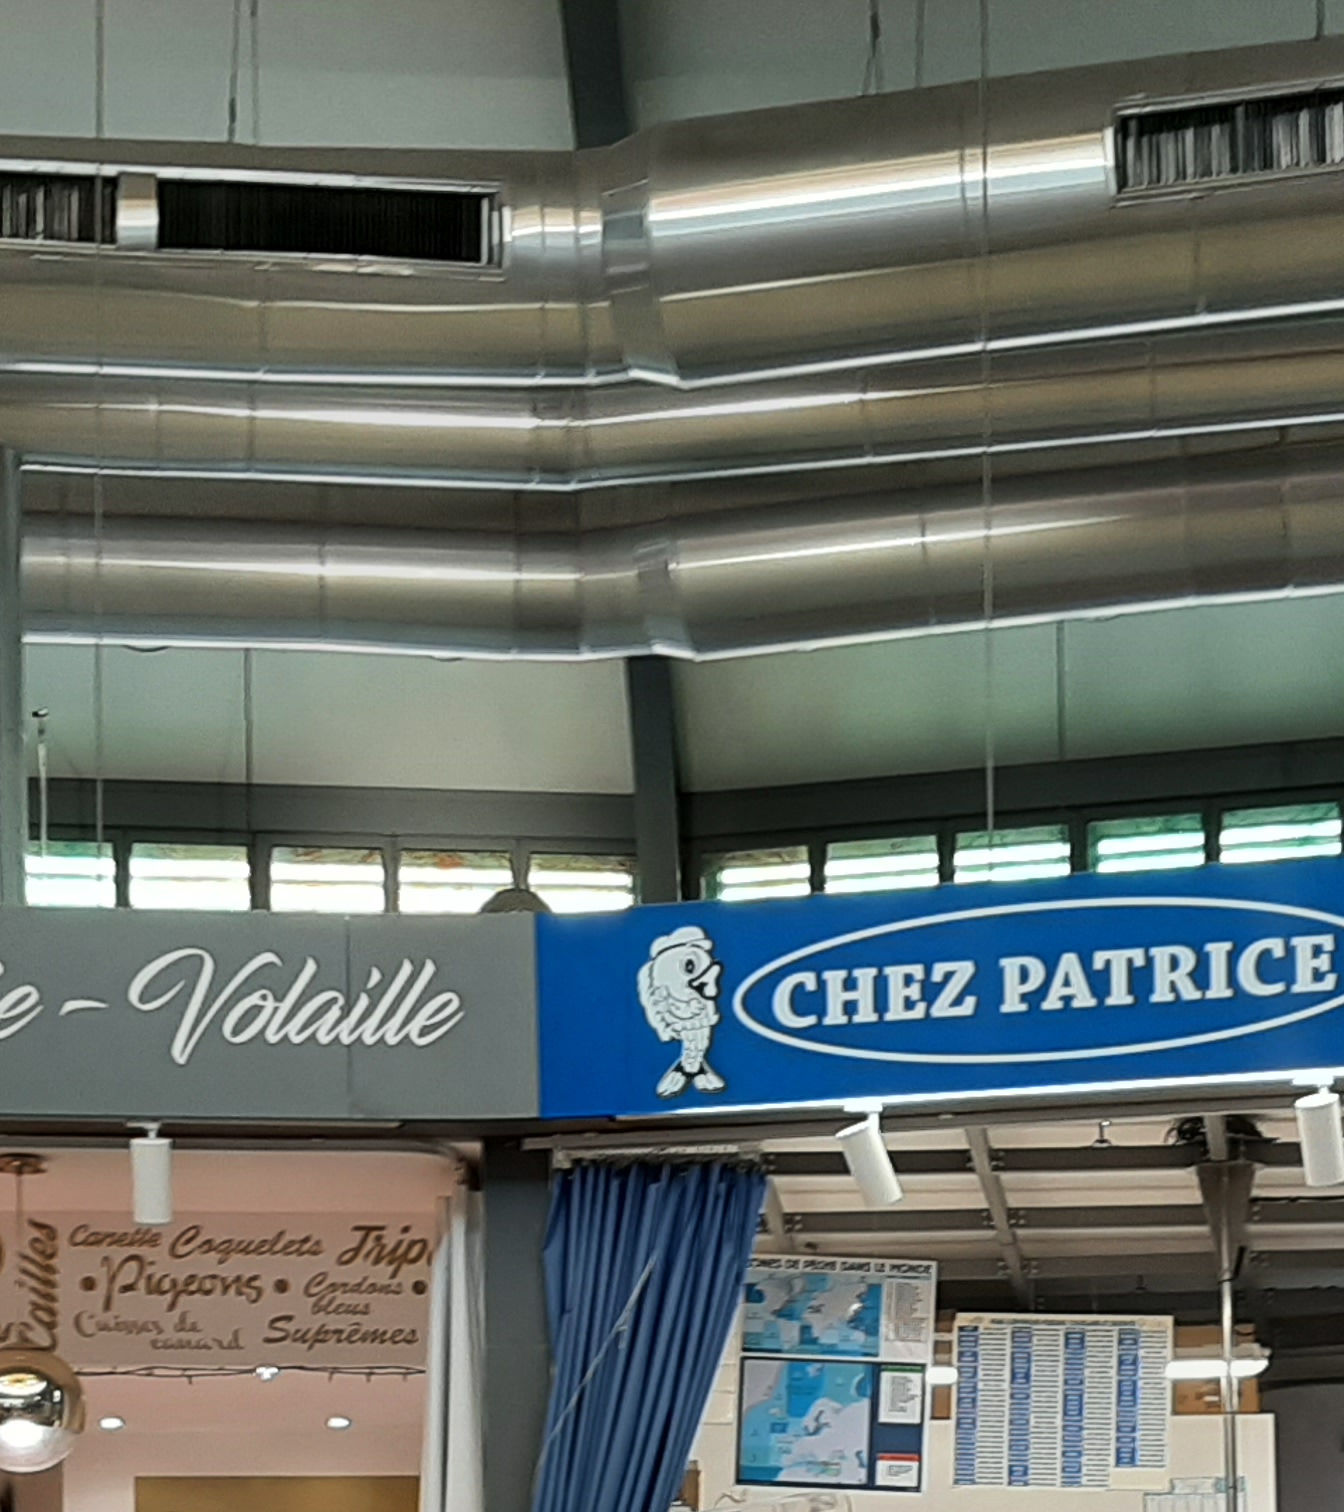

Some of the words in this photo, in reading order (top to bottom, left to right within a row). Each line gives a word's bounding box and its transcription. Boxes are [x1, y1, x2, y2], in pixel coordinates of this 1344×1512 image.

[127, 946, 465, 1065] Volaille
[770, 958, 978, 1030] CHEZ
[999, 933, 1338, 1015] PATRICE
[68, 1223, 163, 1249] Canette
[169, 1224, 326, 1265] Coquelets
[336, 1224, 435, 1280] Trip
[100, 1253, 266, 1314] Pigeons
[303, 1270, 404, 1299] Cordons
[261, 1314, 420, 1352] Suprêmes
